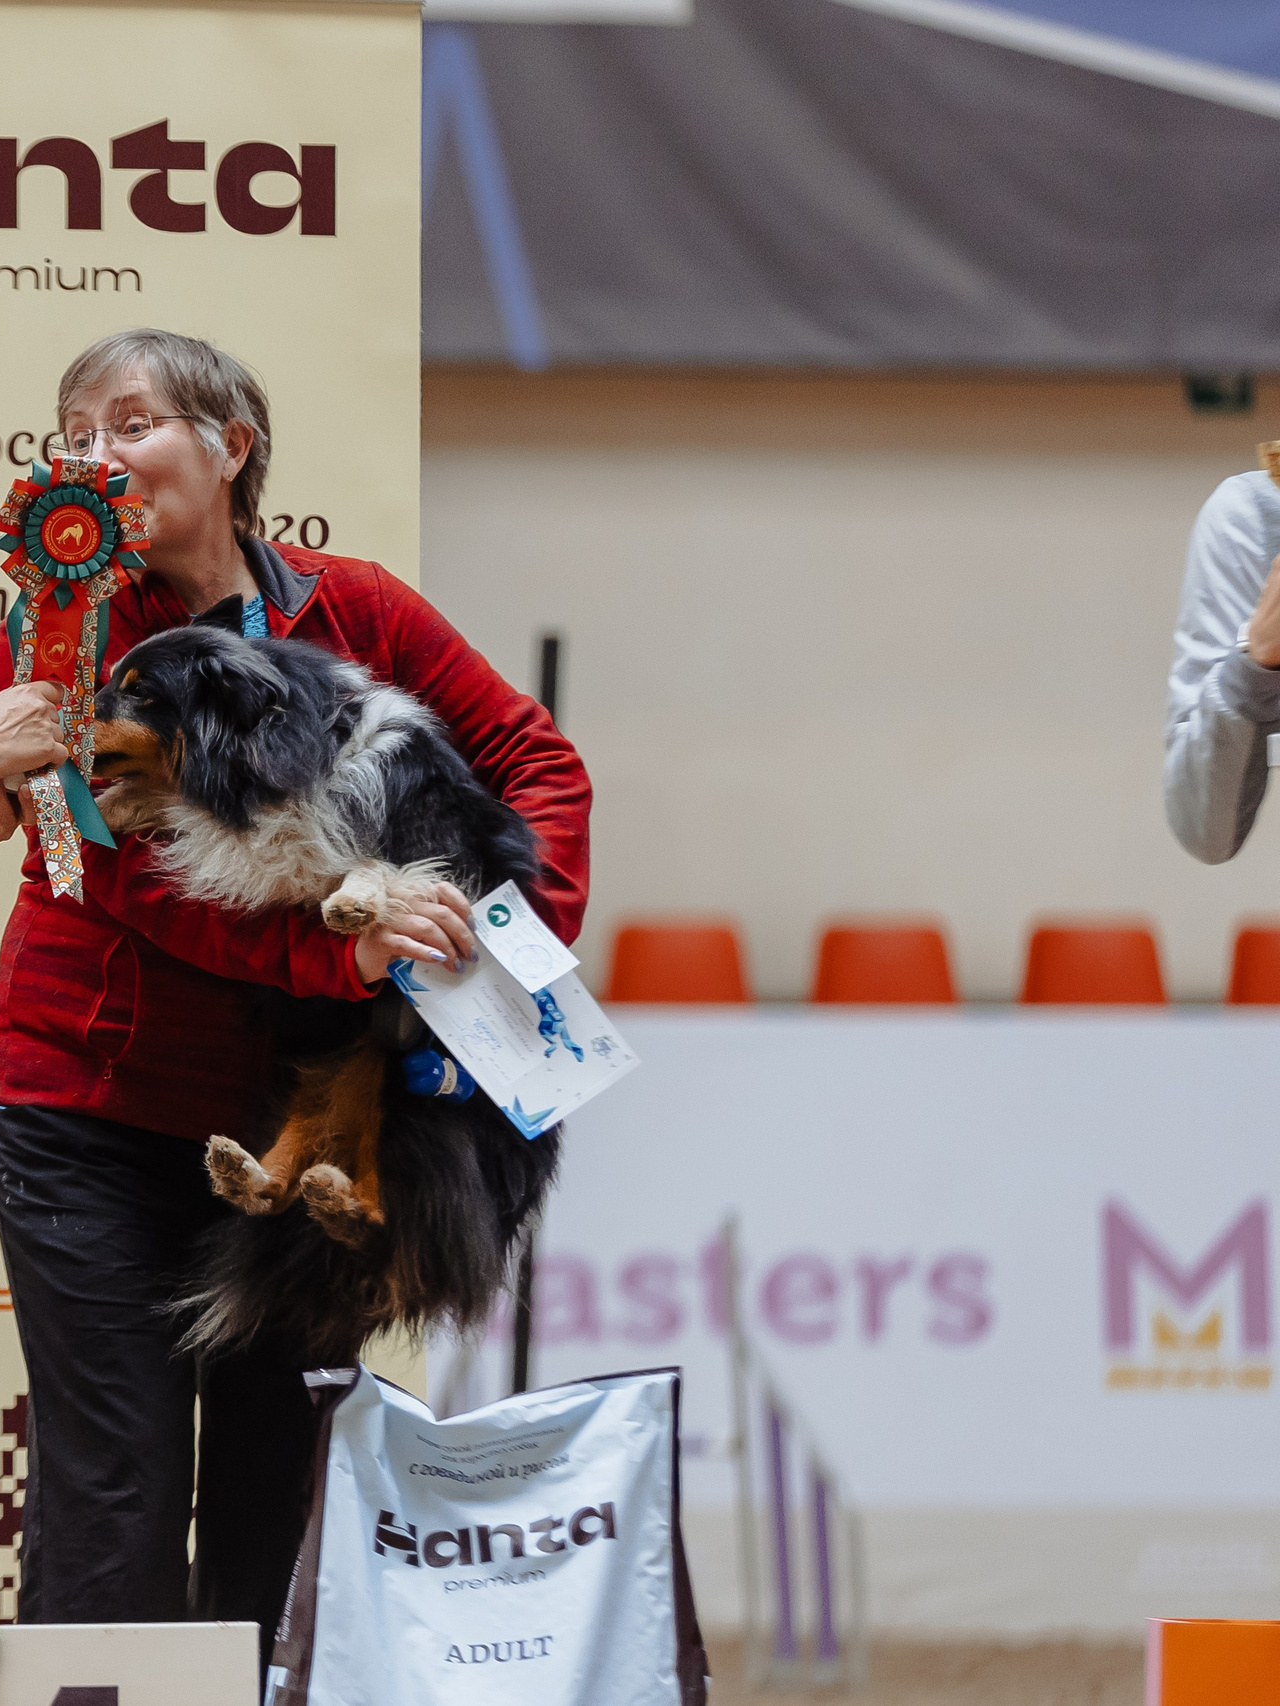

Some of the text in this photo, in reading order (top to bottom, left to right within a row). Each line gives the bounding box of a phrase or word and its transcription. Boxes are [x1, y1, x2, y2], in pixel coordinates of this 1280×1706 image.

[490, 1228, 994, 1345] asters
[373, 1501, 617, 1569] Hanta
[444, 1568, 547, 1594] premium
[444, 1635, 555, 1665] ADULT
